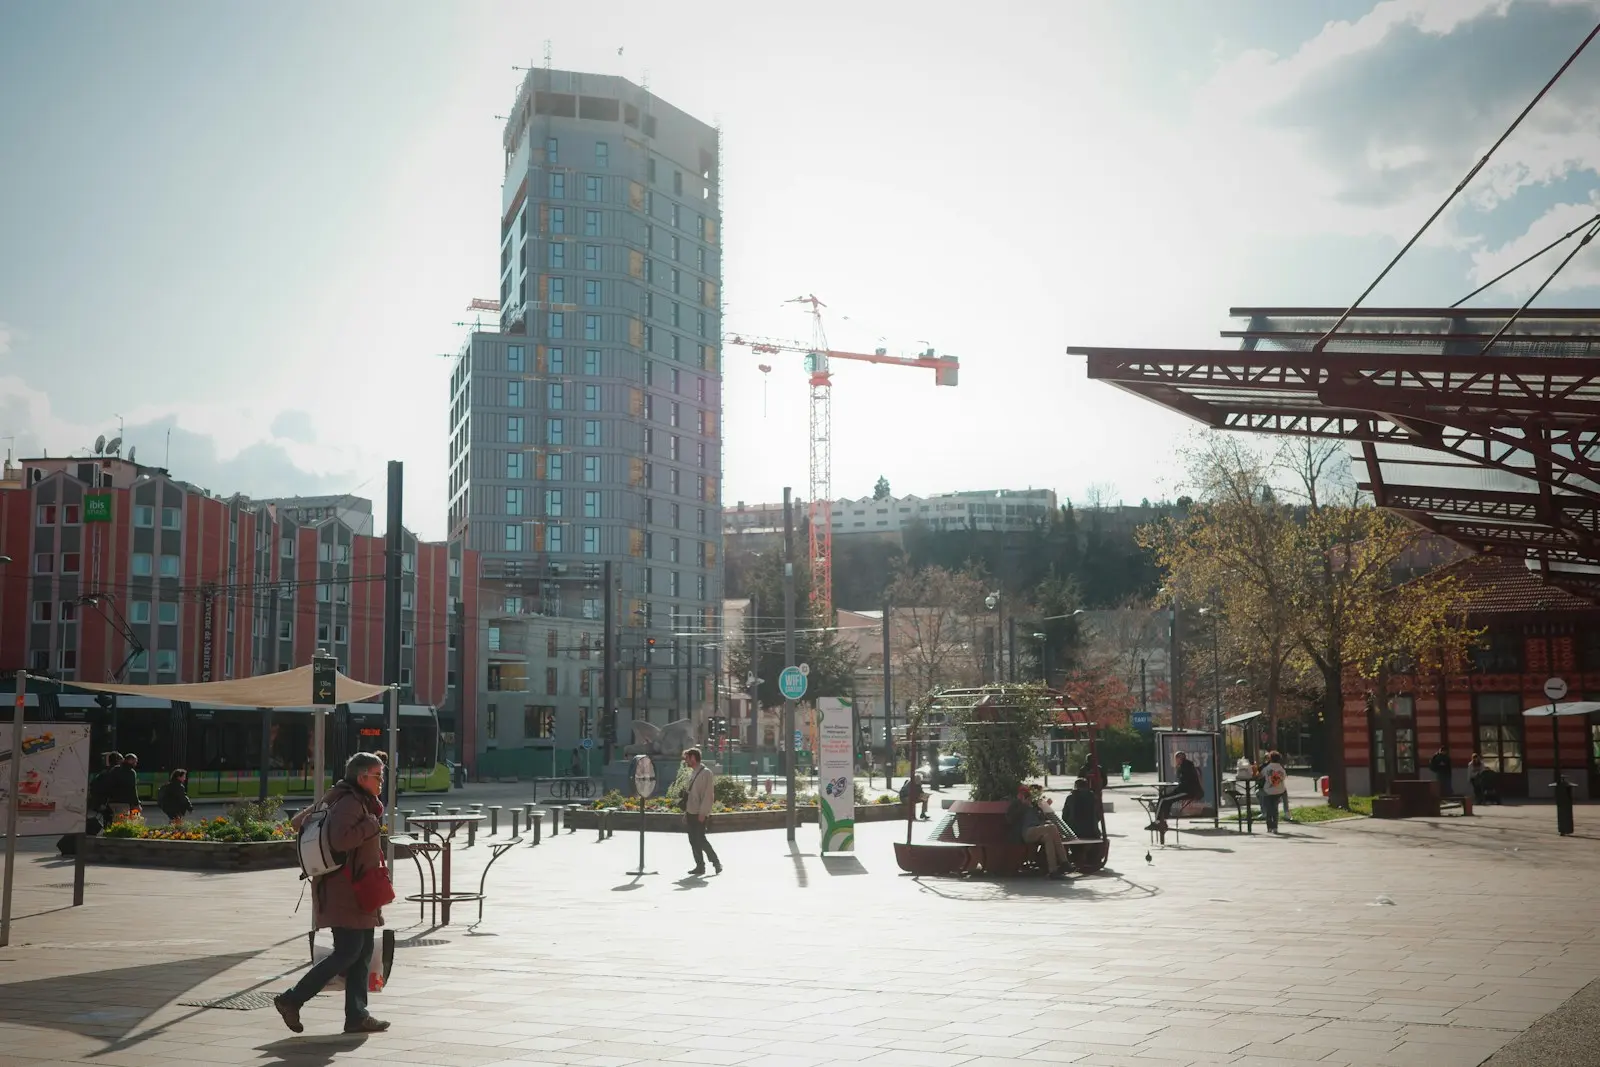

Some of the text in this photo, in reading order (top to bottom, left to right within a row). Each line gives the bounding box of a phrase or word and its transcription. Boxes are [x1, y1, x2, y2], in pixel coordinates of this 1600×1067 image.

[90, 500, 104, 509] ibis
[204, 597, 212, 629] Taverne
[204, 631, 212, 640] de
[785, 674, 802, 686] WIFI
